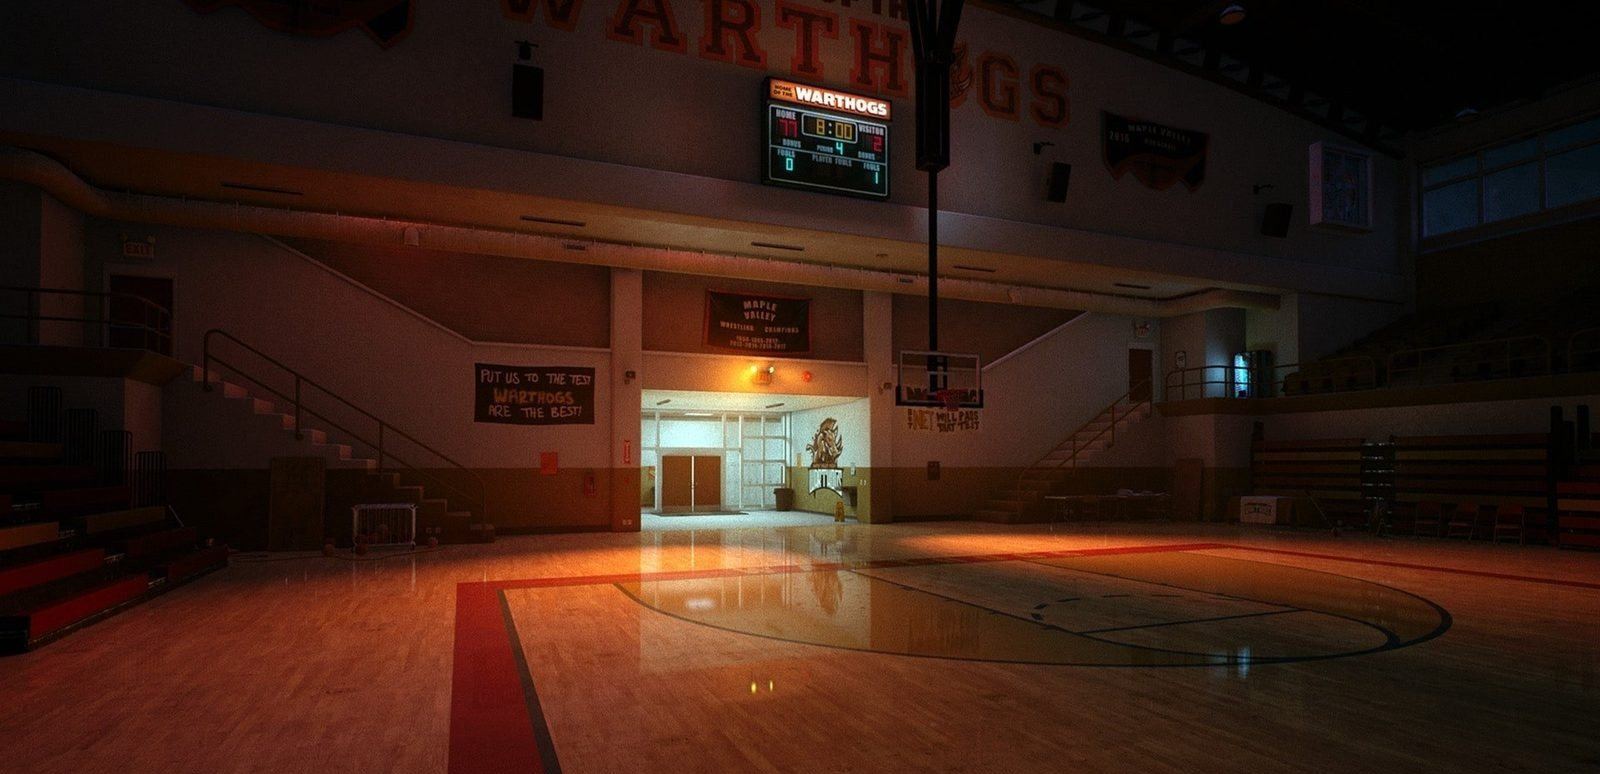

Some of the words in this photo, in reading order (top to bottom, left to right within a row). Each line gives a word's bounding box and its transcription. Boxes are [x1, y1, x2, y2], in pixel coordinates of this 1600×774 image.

[502, 0, 1070, 129] ARTHGS
[795, 86, 887, 116] WARTHOGS
[775, 109, 796, 120] HOME
[816, 118, 853, 140] 8:00
[858, 123, 885, 136] VISITOR
[782, 138, 801, 149] BONUS
[816, 145, 834, 154] PERIOD
[835, 141, 844, 155] 4
[872, 135, 882, 152] 2
[777, 148, 796, 159] FOULS
[858, 150, 876, 161] BONUS
[785, 158, 794, 171] 0
[811, 154, 833, 164] PLAYER
[835, 157, 852, 167] FOULS
[863, 161, 880, 172] FOULS
[743, 299, 777, 312] MAPLE
[743, 310, 777, 322] VALLEY
[719, 321, 755, 332] WRESTLING
[764, 326, 800, 334] CHAMPIONS
[480, 368, 502, 384] PUT
[505, 371, 520, 385] US
[524, 373, 539, 383] TO
[545, 372, 567, 386] THE
[568, 374, 592, 386] TEST
[493, 386, 575, 406] WARTHOGS
[488, 404, 512, 418] ARE
[520, 406, 545, 419] THE
[550, 405, 583, 419] BEST!
[936, 412, 958, 423] WILL
[958, 410, 980, 422] PASS
[957, 421, 980, 431] TEST
